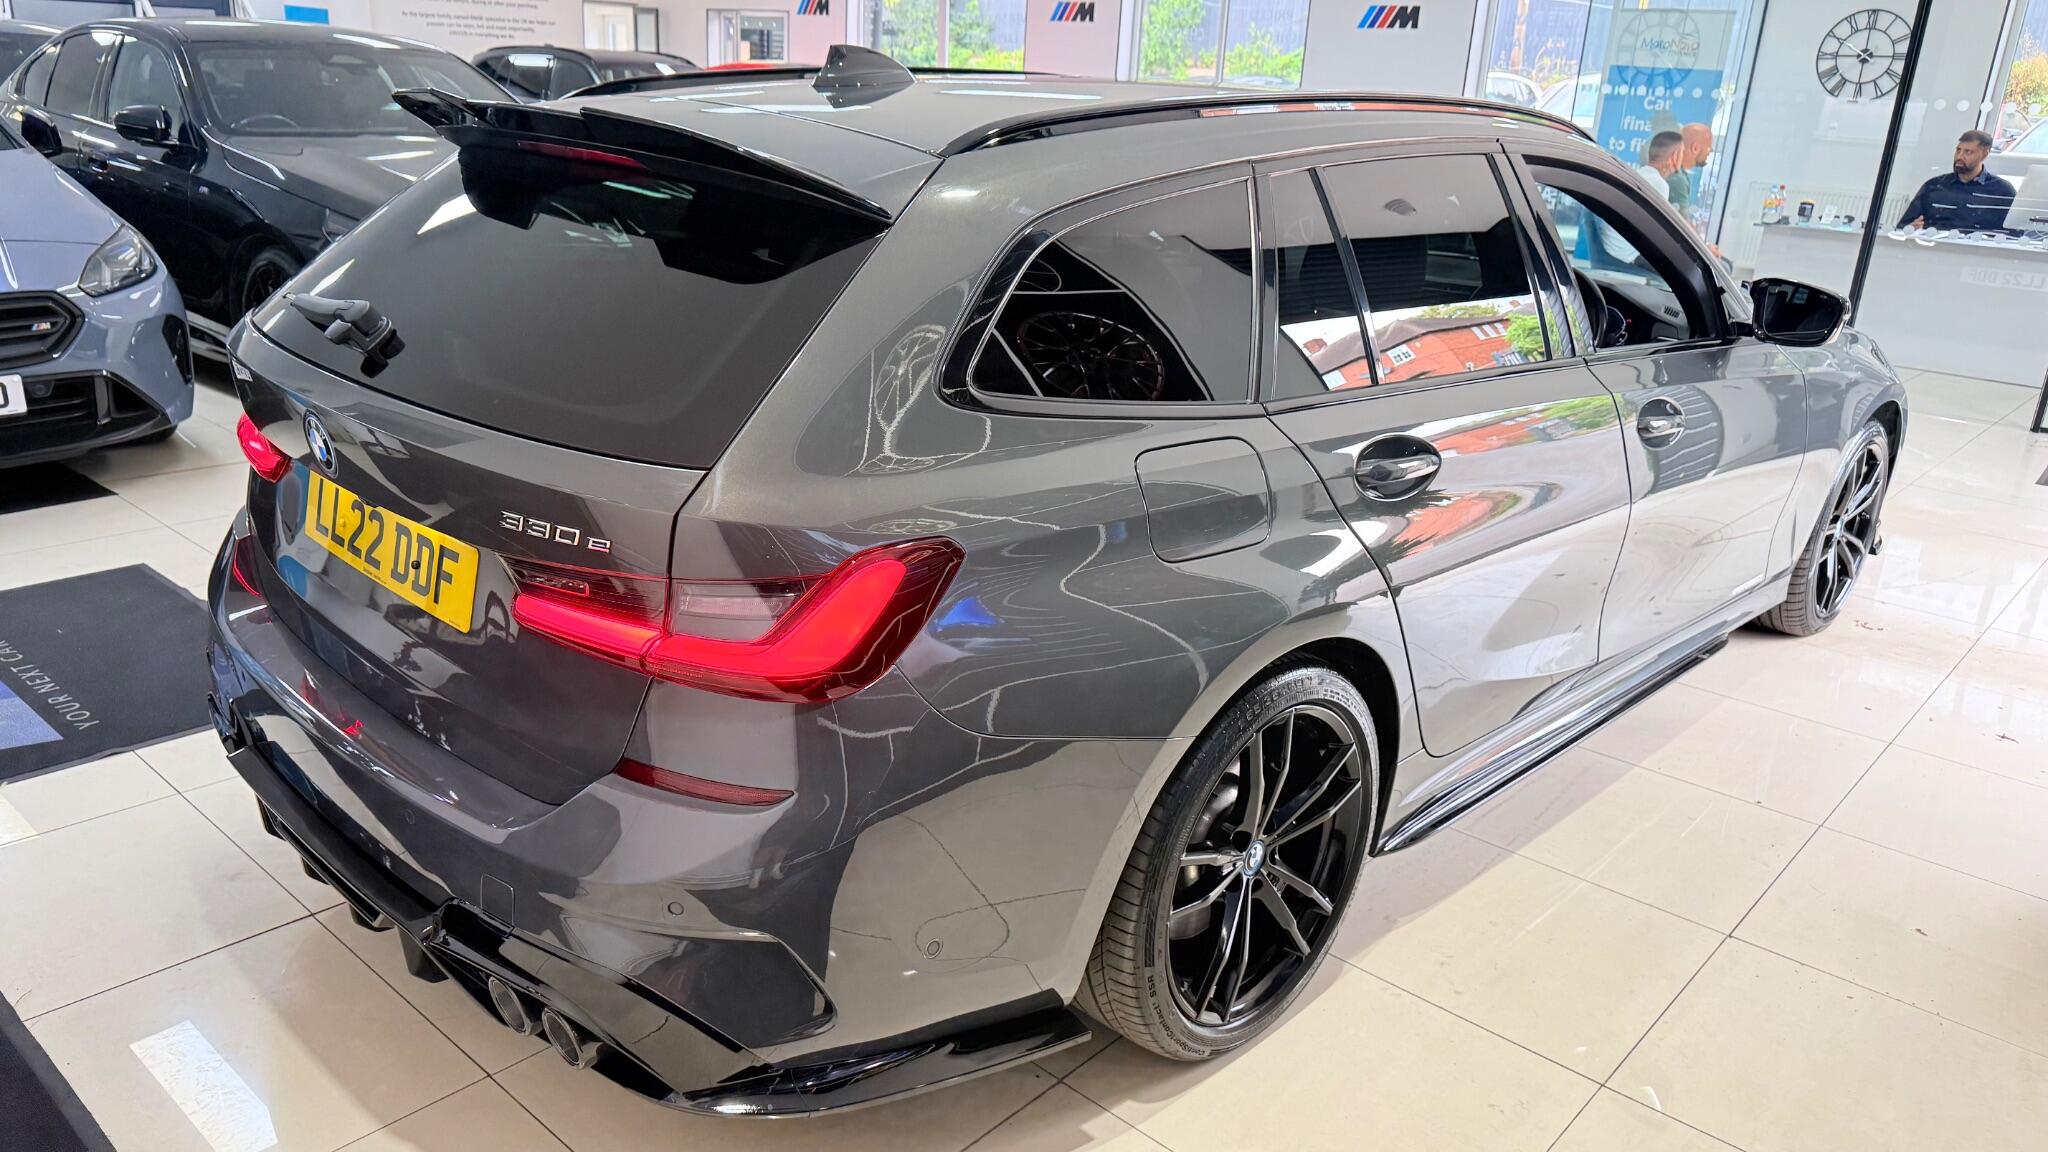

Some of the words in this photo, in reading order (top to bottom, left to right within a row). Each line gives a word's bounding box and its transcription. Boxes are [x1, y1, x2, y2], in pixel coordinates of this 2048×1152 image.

[1609, 136, 1626, 151] to
[315, 478, 385, 571] LL22
[391, 521, 460, 605] DDF
[10, 664, 60, 694] NEXT
[48, 694, 100, 731] YOUR
